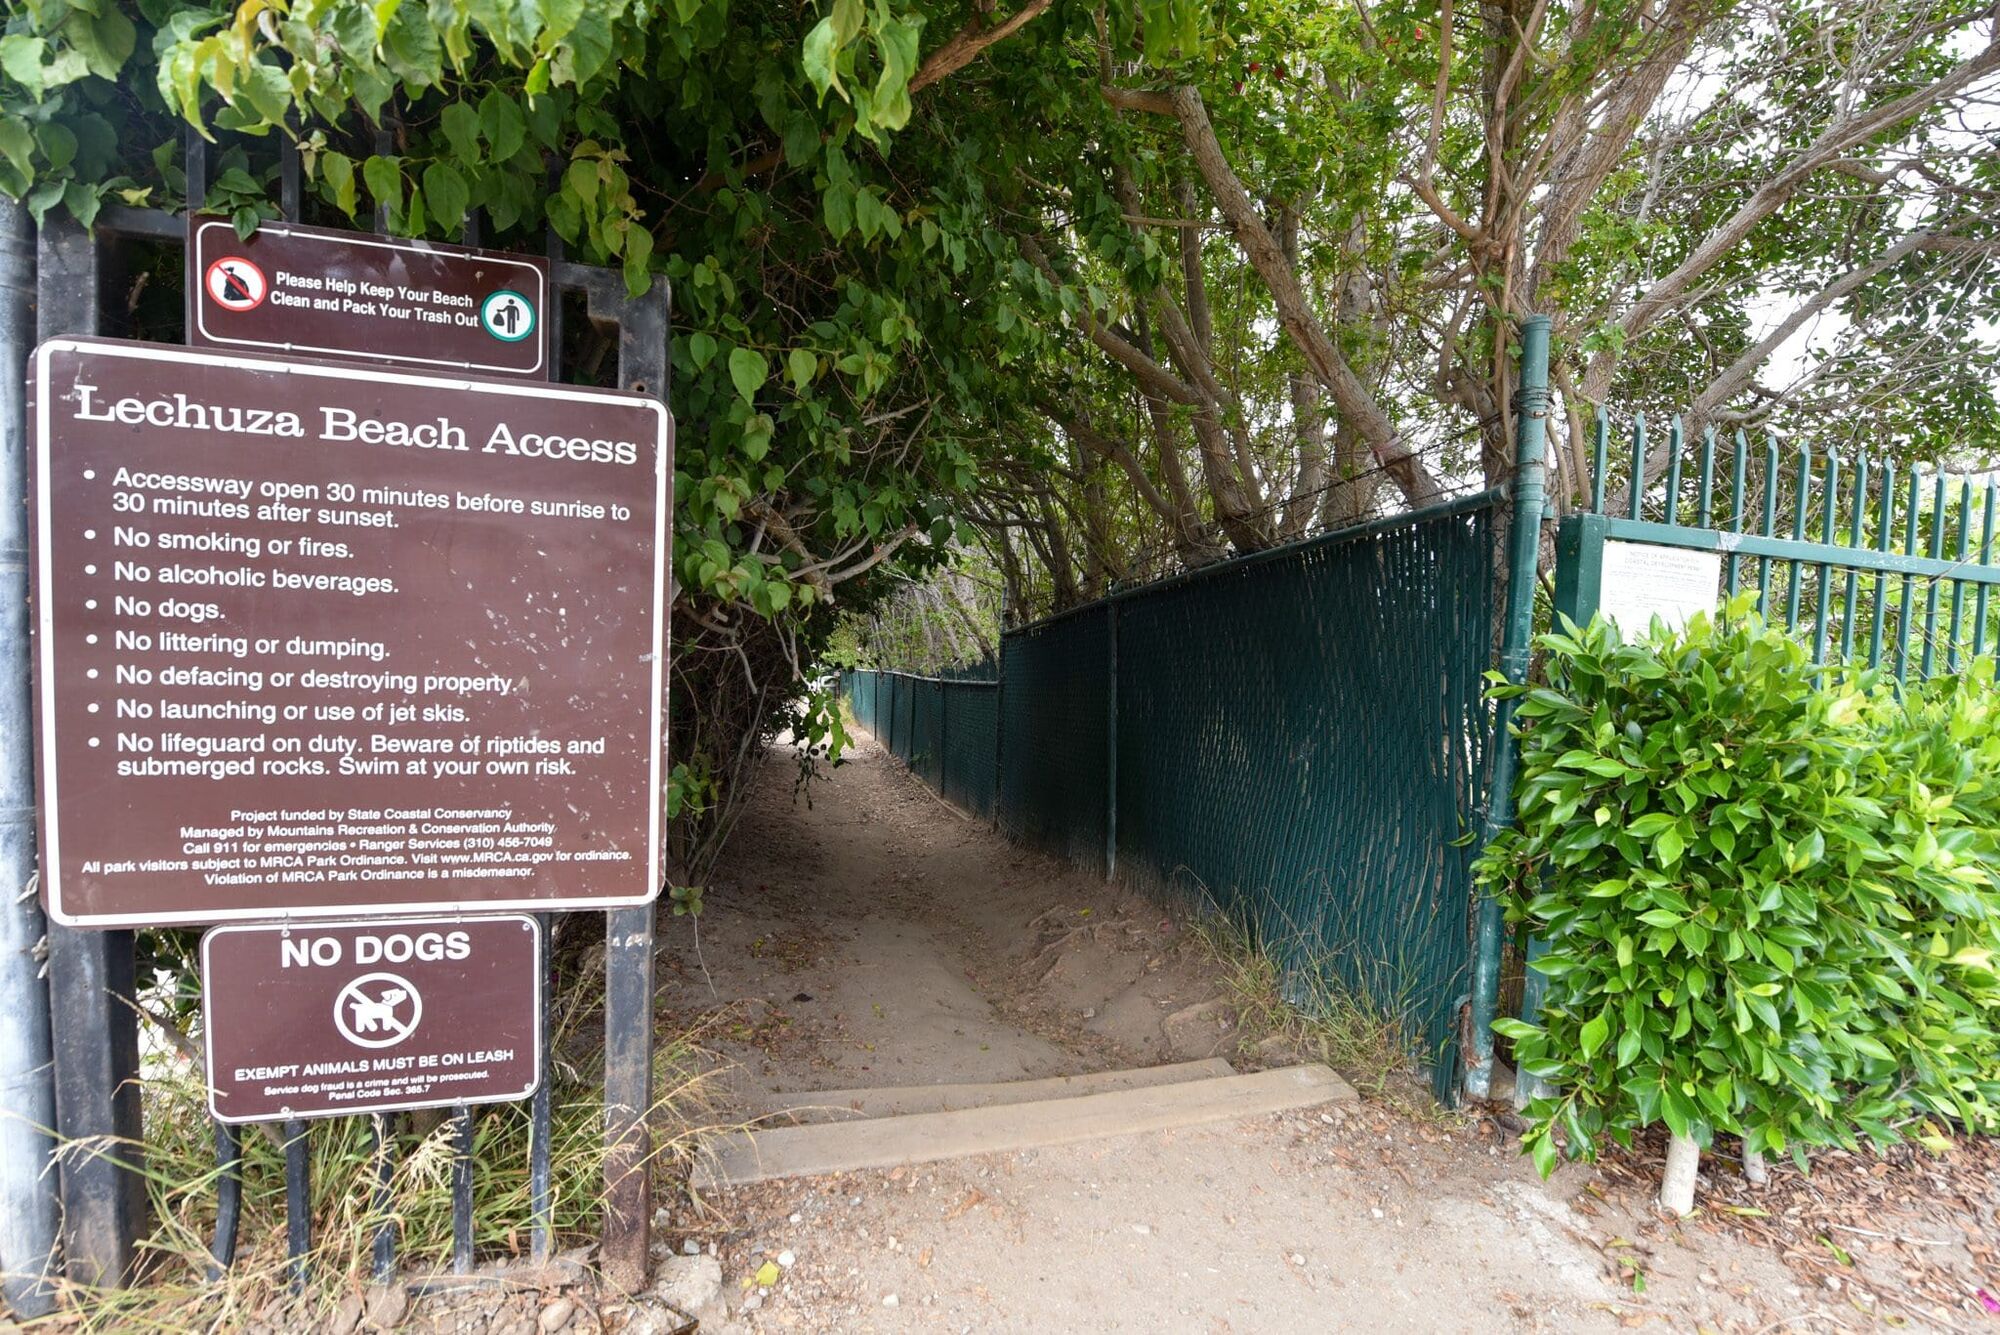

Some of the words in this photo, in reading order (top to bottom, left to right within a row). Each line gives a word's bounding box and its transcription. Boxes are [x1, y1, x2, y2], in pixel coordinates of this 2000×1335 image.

[276, 272, 322, 289] Please
[325, 278, 357, 296] Help
[360, 282, 395, 301] Keep
[397, 287, 430, 302] Your
[432, 291, 473, 307] Beach
[270, 291, 310, 308] Clean
[313, 299, 340, 311] and
[343, 299, 376, 315] Pack
[379, 303, 412, 319] Your
[413, 308, 452, 324] Trash
[454, 313, 478, 327] Out
[73, 385, 305, 437] Lechuza
[319, 407, 470, 451] Beach
[481, 423, 637, 464] Access
[112, 468, 253, 499] Accessway
[259, 482, 319, 502] open
[326, 483, 356, 502] 30
[362, 487, 450, 509] minutes
[456, 492, 525, 514] before
[530, 500, 606, 519] sunrise
[610, 504, 630, 521] to
[112, 492, 145, 512] 30
[153, 496, 250, 519] minutes
[257, 502, 312, 522] after
[317, 510, 399, 528] sunset.
[113, 527, 150, 547] No
[157, 532, 260, 558] smoking
[267, 540, 293, 554] or
[297, 537, 354, 558] fires.
[114, 561, 151, 582] No
[157, 564, 266, 587] alcoholic
[272, 569, 399, 596] beverages.
[115, 596, 151, 616] No
[158, 599, 226, 623] dogs.
[115, 631, 152, 650] No
[159, 632, 248, 658] littering
[254, 639, 280, 654] or
[285, 637, 390, 661] dumping.
[116, 665, 152, 685] No
[159, 666, 263, 691] defacing
[269, 673, 295, 687] or
[300, 670, 418, 694] destroying
[424, 674, 518, 696] property.
[116, 699, 153, 718] No
[160, 700, 276, 724] launching
[283, 706, 308, 720] or
[314, 706, 356, 721] use
[361, 703, 384, 721] of
[388, 703, 416, 726] jet
[422, 704, 470, 722] skis.
[117, 733, 154, 752] No
[161, 733, 265, 757] lifeguard
[271, 738, 301, 752] on
[308, 735, 363, 760] duty.
[371, 735, 454, 753] Beware
[459, 735, 481, 754] of
[487, 736, 562, 757] riptides
[566, 738, 605, 754] and
[117, 757, 255, 780] submerged
[263, 757, 330, 775] rocks.
[338, 754, 399, 775] Swim
[405, 759, 427, 775] at
[432, 761, 481, 779] your
[485, 761, 529, 775] own
[535, 758, 576, 775] risk.
[230, 810, 278, 824] Project
[280, 810, 326, 821] funded
[328, 810, 345, 822] by
[347, 809, 381, 820] State
[383, 809, 432, 819] Coastal
[433, 808, 512, 821] Conservancy
[180, 827, 244, 840] Managed
[247, 827, 264, 839] by
[267, 825, 334, 836] Mountains
[337, 824, 406, 835] Recreation
[408, 824, 418, 834] &
[421, 823, 501, 834] Conservation
[502, 823, 555, 836] Authority
[182, 843, 210, 854] Call
[213, 843, 238, 854] 911
[242, 842, 262, 853] for
[263, 841, 347, 854] emergencies
[359, 840, 406, 852] Ranger
[407, 839, 461, 849] Services
[463, 838, 495, 850] (310)
[497, 837, 553, 847] 456-7049
[81, 862, 100, 873] All
[103, 861, 136, 875] park
[138, 860, 189, 871] visitors
[191, 858, 240, 871] subject
[243, 858, 257, 868] to
[259, 856, 304, 868] MRCA
[307, 856, 337, 866] Park
[339, 855, 408, 866] Ordinance.
[411, 854, 438, 864] Visit
[440, 852, 554, 864] www.MRCA.ca.gov
[555, 851, 572, 861] for
[573, 851, 632, 861] ordinance.
[203, 873, 262, 885] Violation
[265, 872, 279, 883] of
[281, 871, 325, 882] MRCA
[328, 871, 358, 881] Park
[360, 870, 425, 880] Ordinance
[427, 868, 438, 879] is
[440, 870, 450, 878] a
[451, 868, 535, 878] misdemeanor.
[281, 937, 342, 968] NO
[355, 932, 471, 964] DOGS
[234, 1065, 300, 1081] EXEMPT
[302, 1060, 370, 1076] ANIMALS
[372, 1057, 416, 1071] MUST
[418, 1055, 438, 1067] BE
[441, 1053, 464, 1065] ON
[467, 1050, 514, 1064] LEASH
[263, 1086, 300, 1096] Service
[300, 1085, 320, 1093] dog
[320, 1082, 345, 1091] fraud
[364, 1080, 390, 1088] crime
[391, 1077, 409, 1085] and
[409, 1076, 425, 1084] will
[425, 1075, 438, 1083] be
[439, 1071, 490, 1083] prosecuted.
[328, 1091, 355, 1100] Penal
[356, 1089, 382, 1098] Code
[383, 1088, 403, 1096] Sec.
